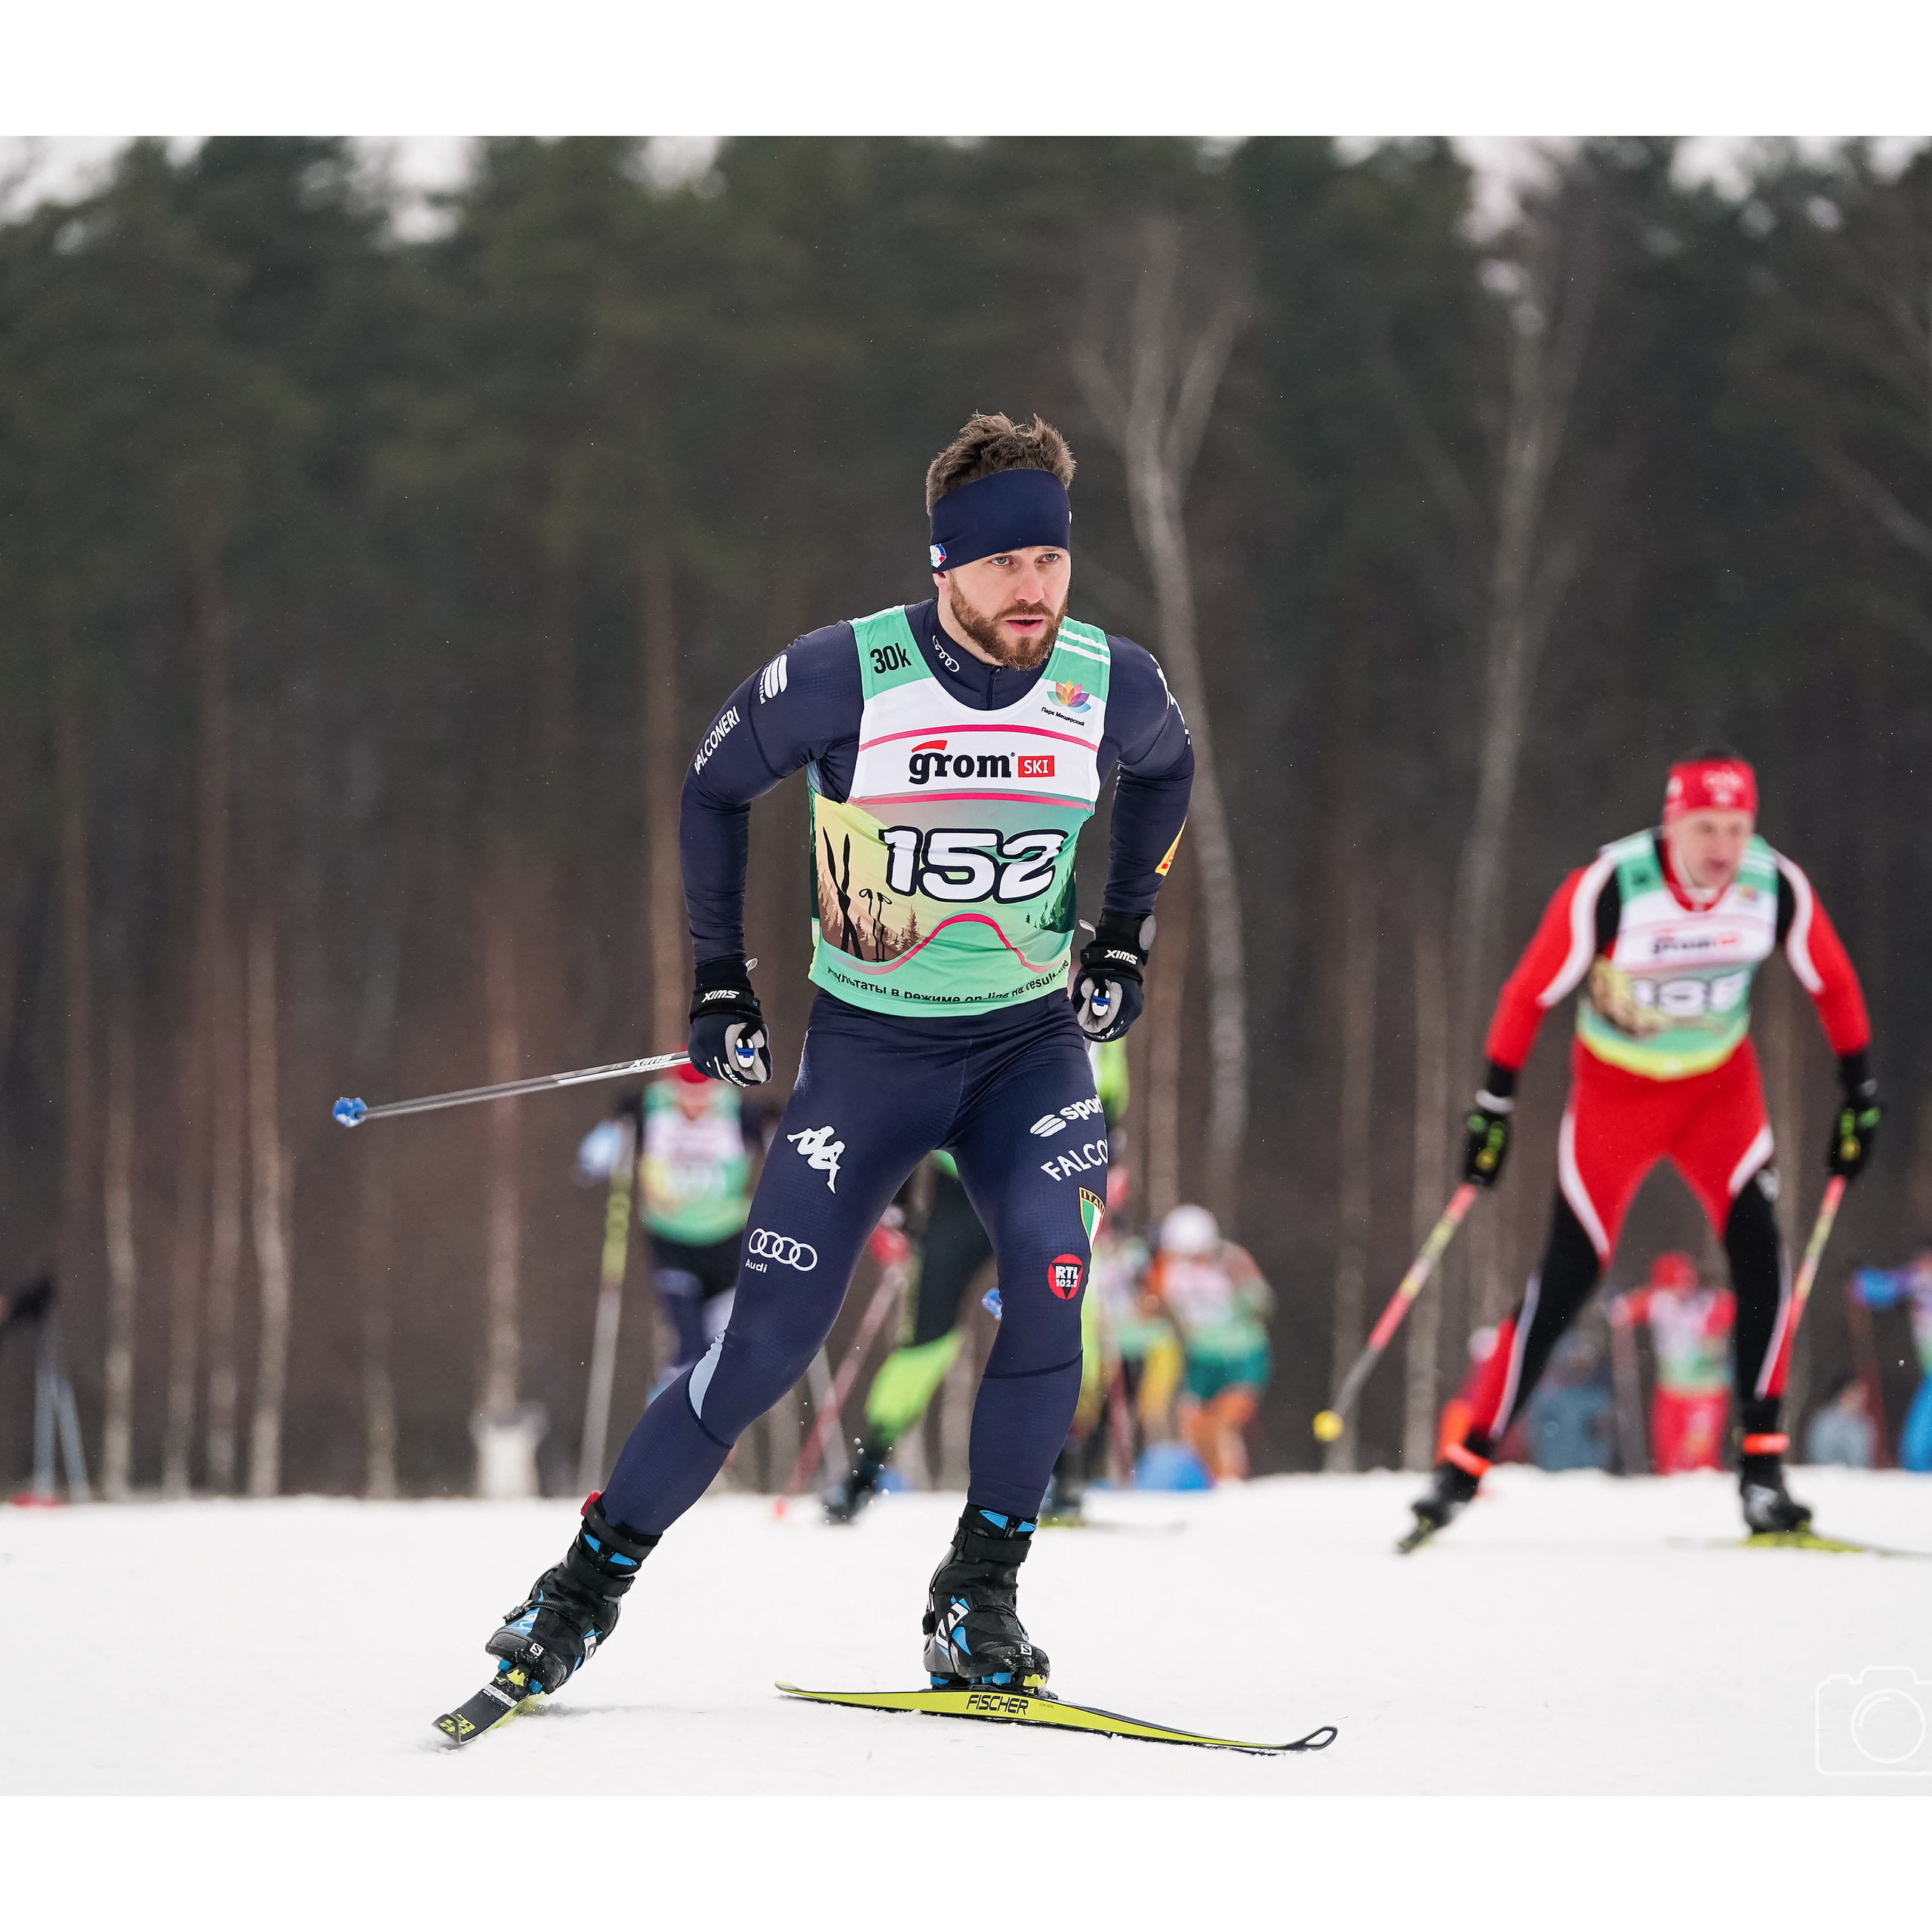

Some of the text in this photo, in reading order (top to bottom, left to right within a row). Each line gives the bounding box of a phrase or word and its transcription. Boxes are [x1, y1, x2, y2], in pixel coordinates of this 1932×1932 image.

[870, 642, 912, 674] 30k
[1041, 706, 1055, 715] Парк
[909, 752, 1048, 785] grom SKI
[878, 826, 1069, 903] 152
[828, 966, 886, 994] ультаты
[904, 992, 960, 1002] режиме
[1011, 986, 1024, 997] на
[1040, 1139, 1108, 1182] FALCO
[745, 1259, 768, 1273] Audi
[1055, 1266, 1078, 1279] RTL
[1055, 1278, 1078, 1287] 102.5
[966, 1694, 1029, 1715] FISCHER
